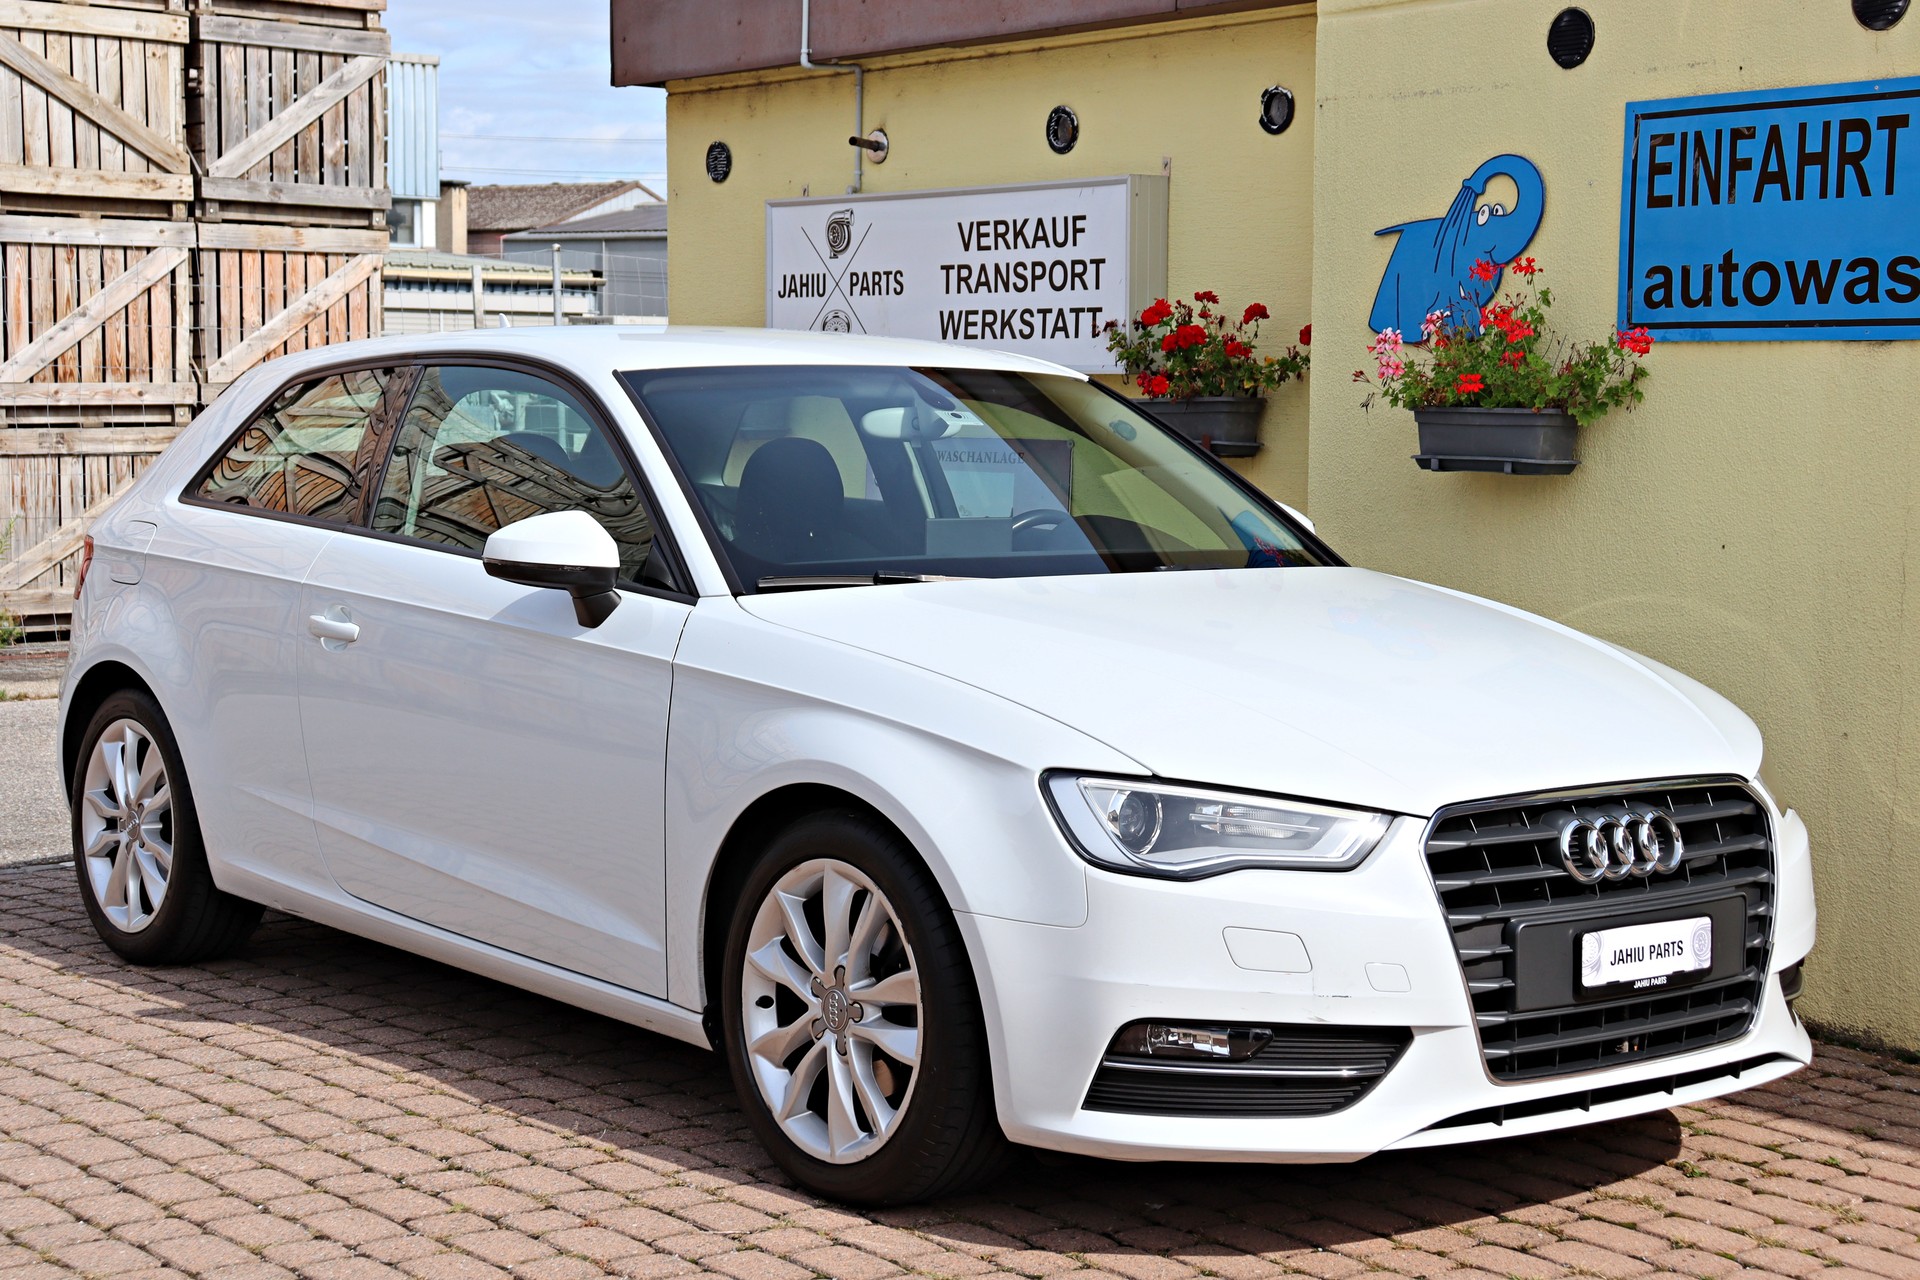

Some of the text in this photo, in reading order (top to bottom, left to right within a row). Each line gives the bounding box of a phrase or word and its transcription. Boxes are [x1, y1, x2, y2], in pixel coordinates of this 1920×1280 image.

[1647, 114, 1910, 208] EINFAHRT
[958, 215, 1087, 252] VERKAUF
[777, 269, 904, 299] JAHIU PARTS
[940, 258, 1106, 295] TRANSPORT
[1643, 248, 1920, 310] autowas
[939, 307, 1103, 341] WERKSTATT
[938, 451, 1025, 464] WASCHANLAGE
[1610, 940, 1683, 965] JAHIU PARTS
[1633, 976, 1667, 988] JAHIU PARTS
